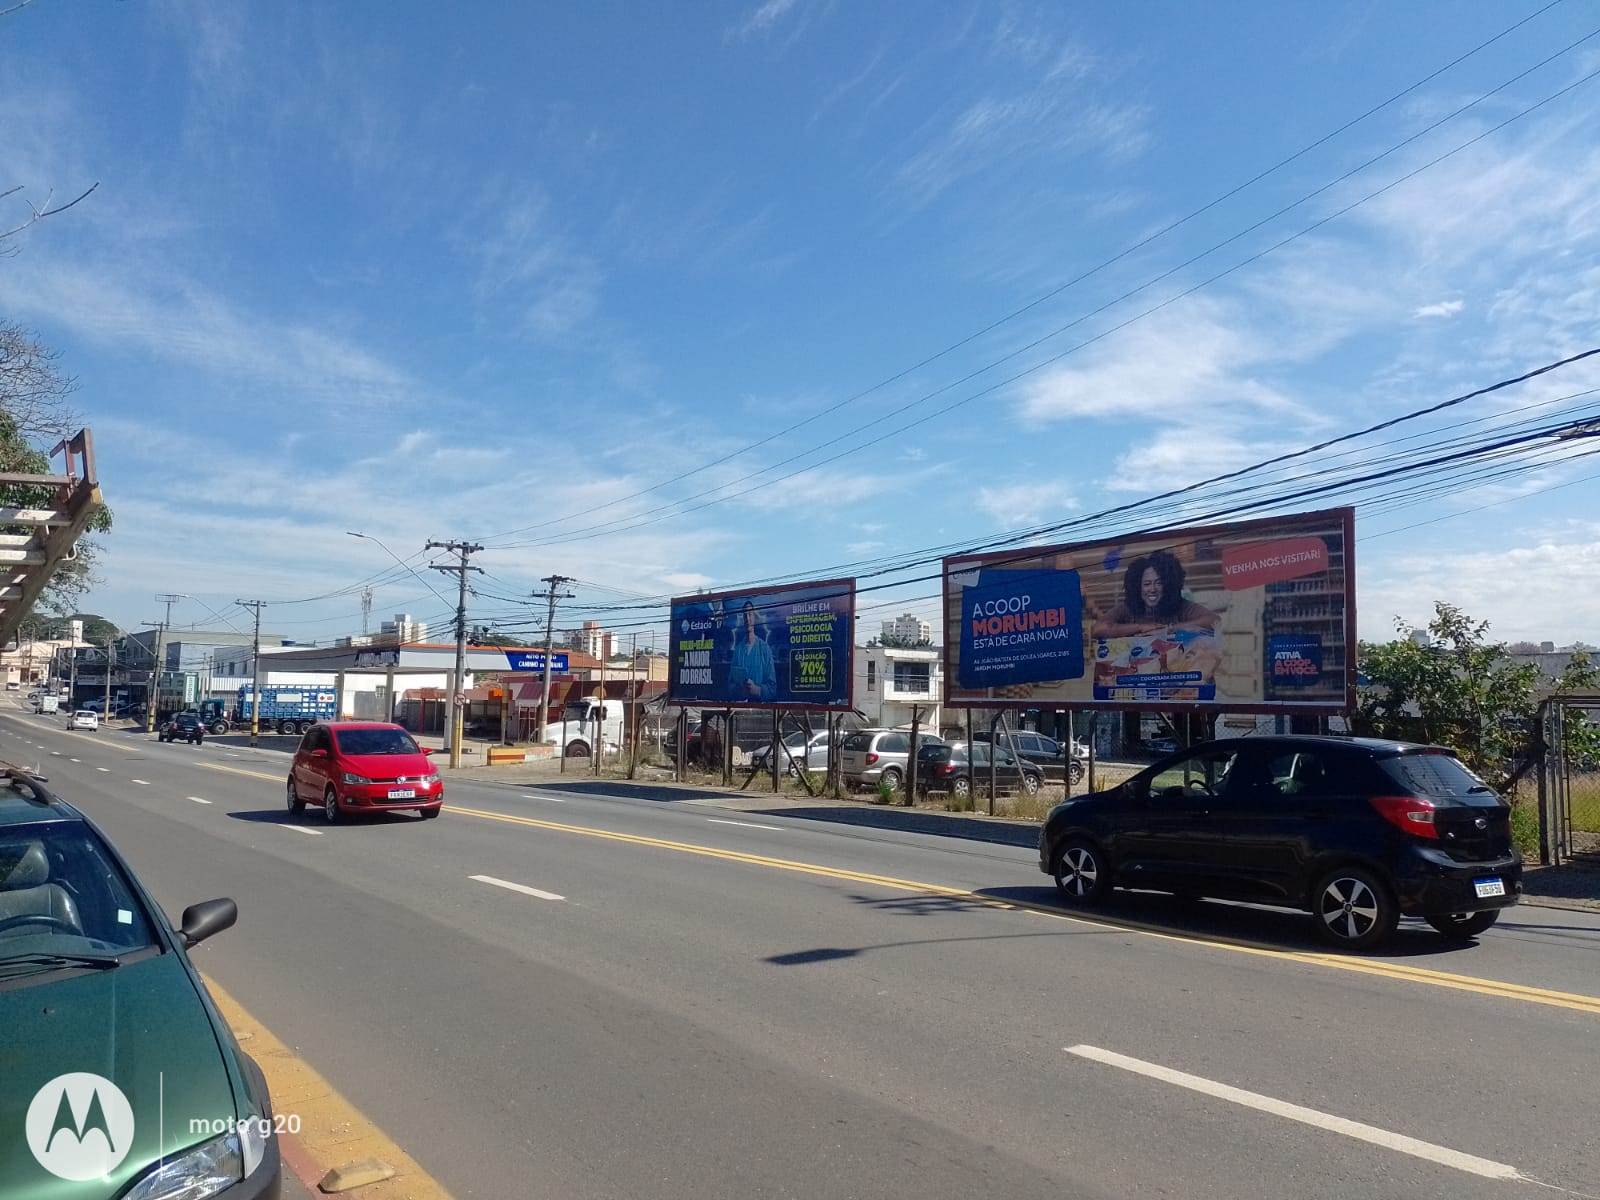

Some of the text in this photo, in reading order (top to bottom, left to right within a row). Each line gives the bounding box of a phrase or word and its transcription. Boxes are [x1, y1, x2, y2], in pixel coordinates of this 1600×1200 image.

[1225, 549, 1321, 575] VENHA NOS VISITAR!
[792, 602, 830, 614] BRILHE EM
[973, 595, 1031, 618] A COOP
[790, 622, 833, 634] PSICOLOGIA
[973, 607, 1065, 638] MORUMBI
[790, 635, 801, 644] OU
[973, 628, 1069, 649] ESTÁ DE CARA NOVA!
[684, 651, 689, 667] A
[689, 651, 710, 667] MAIOR
[1274, 651, 1302, 660] ATIVA
[800, 661, 826, 676] 70%
[680, 669, 690, 684] DO
